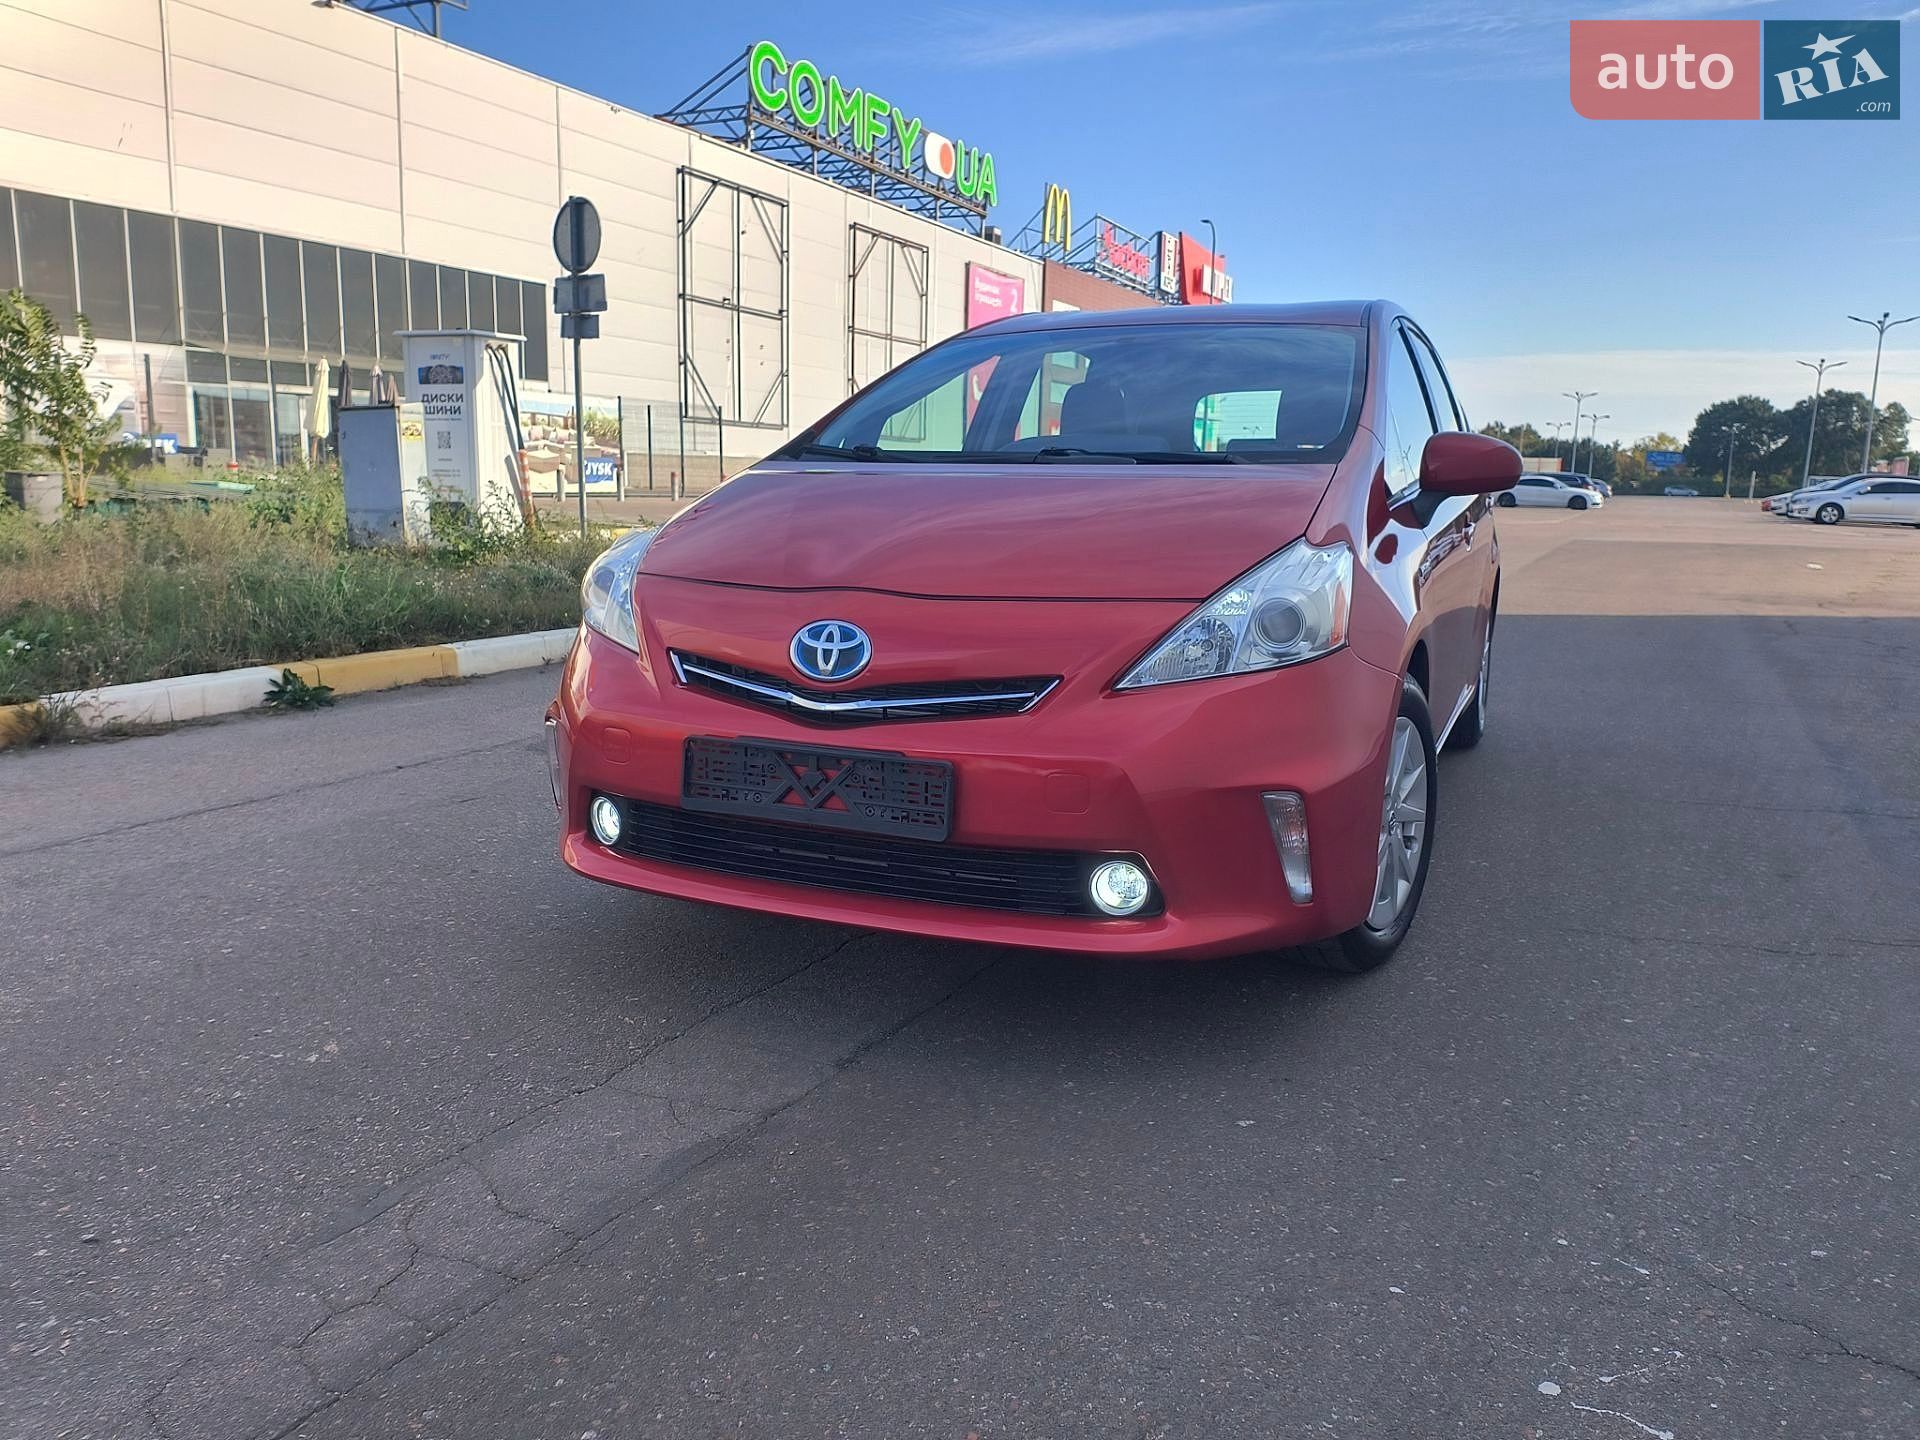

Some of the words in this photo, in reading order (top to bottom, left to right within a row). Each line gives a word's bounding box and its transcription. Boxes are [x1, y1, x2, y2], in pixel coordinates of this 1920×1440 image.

[749, 40, 922, 169] COMFY
[421, 393, 464, 404] ДИСКИ
[425, 405, 462, 415] ШИНИ
[586, 461, 613, 476] JYSK
